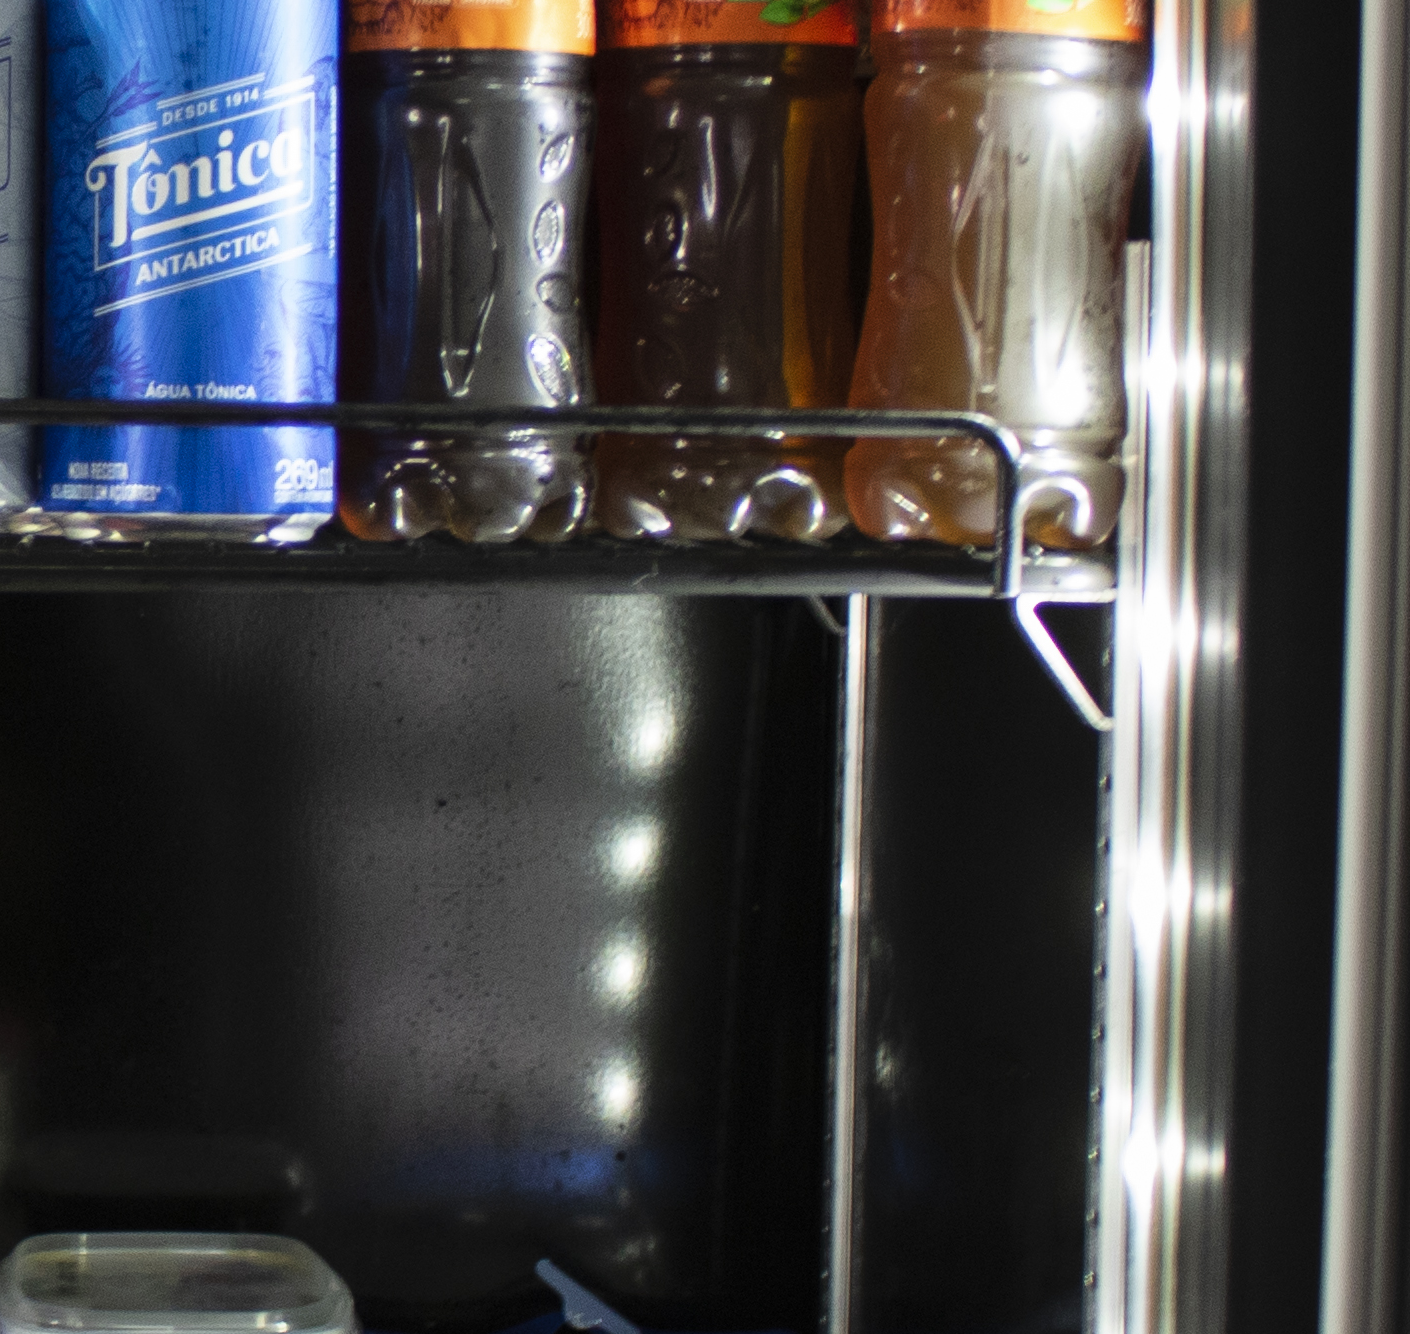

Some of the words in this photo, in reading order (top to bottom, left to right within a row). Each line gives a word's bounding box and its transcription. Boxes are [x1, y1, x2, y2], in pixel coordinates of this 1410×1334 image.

[161, 99, 219, 127] DESDE
[225, 87, 259, 109] 1914
[85, 127, 303, 249] Tônica
[134, 225, 280, 286] ANTARCTICA
[144, 380, 192, 399] ÁGUA
[195, 379, 257, 399] TÔNICA
